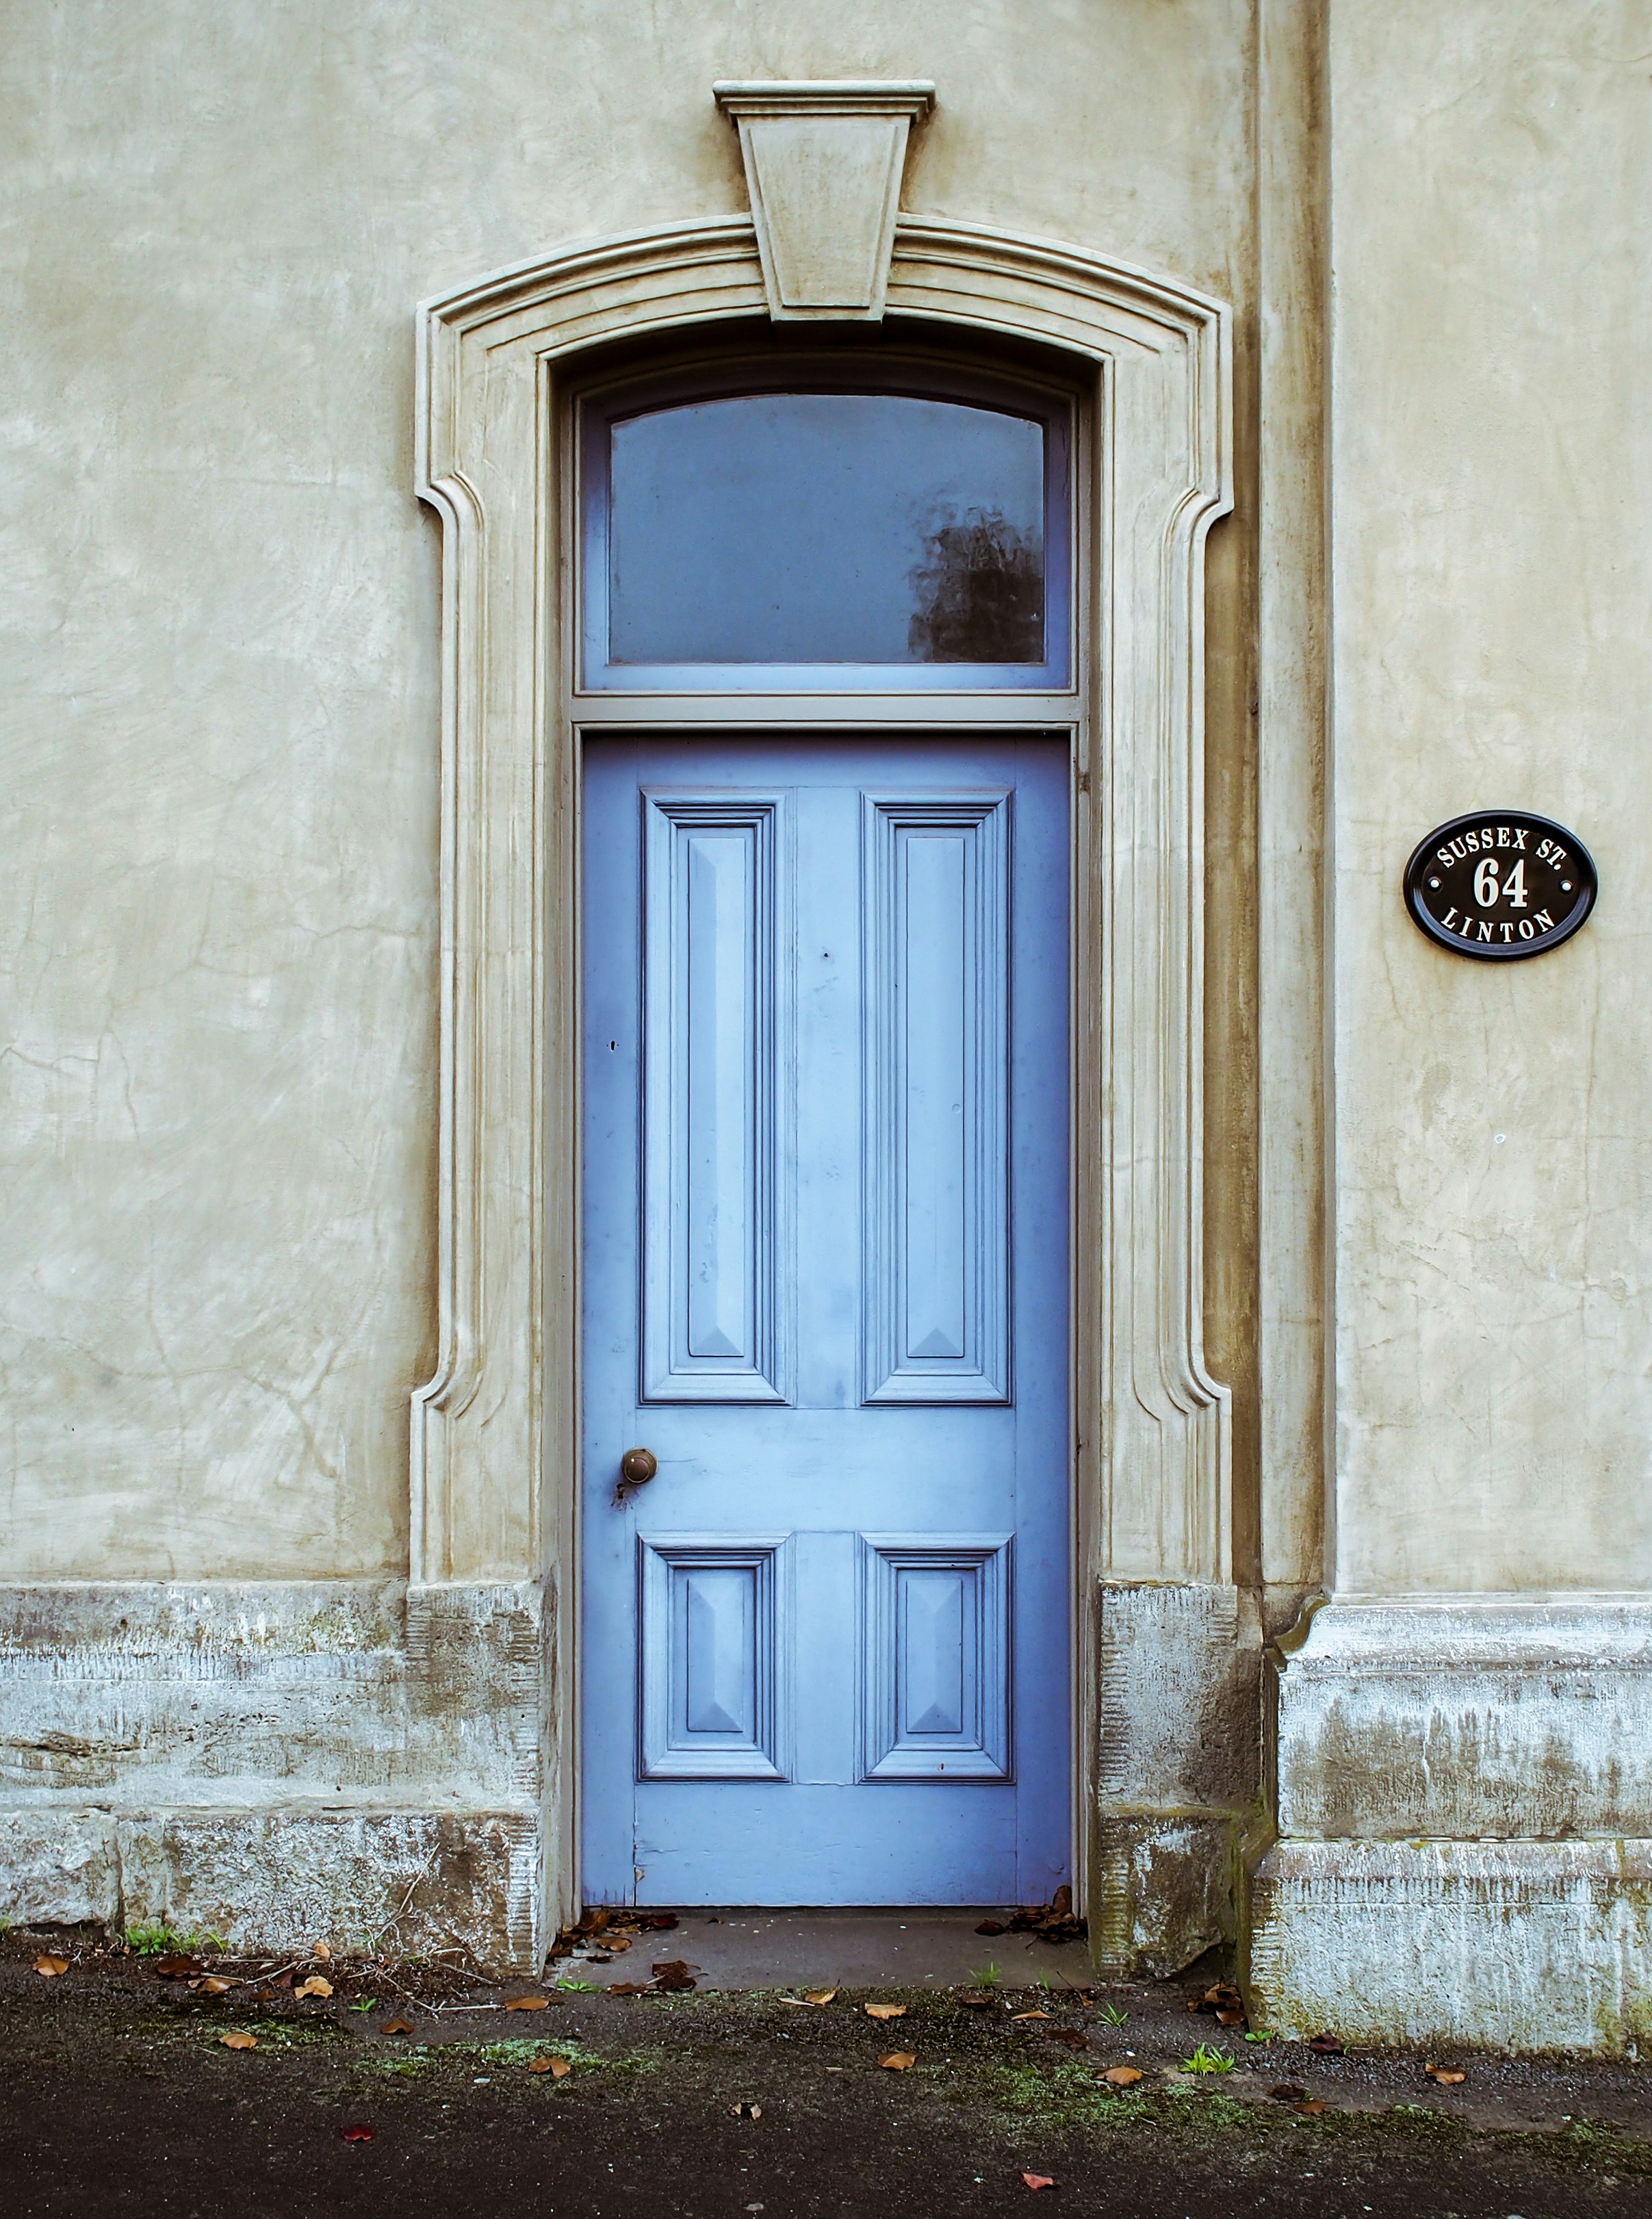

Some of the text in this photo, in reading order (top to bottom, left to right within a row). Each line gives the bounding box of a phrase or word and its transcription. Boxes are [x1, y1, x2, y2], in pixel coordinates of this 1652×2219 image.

[1436, 827, 1567, 871] SUSSEX ST.
[1473, 858, 1528, 908] 64
[1441, 907, 1555, 942] LINTON
